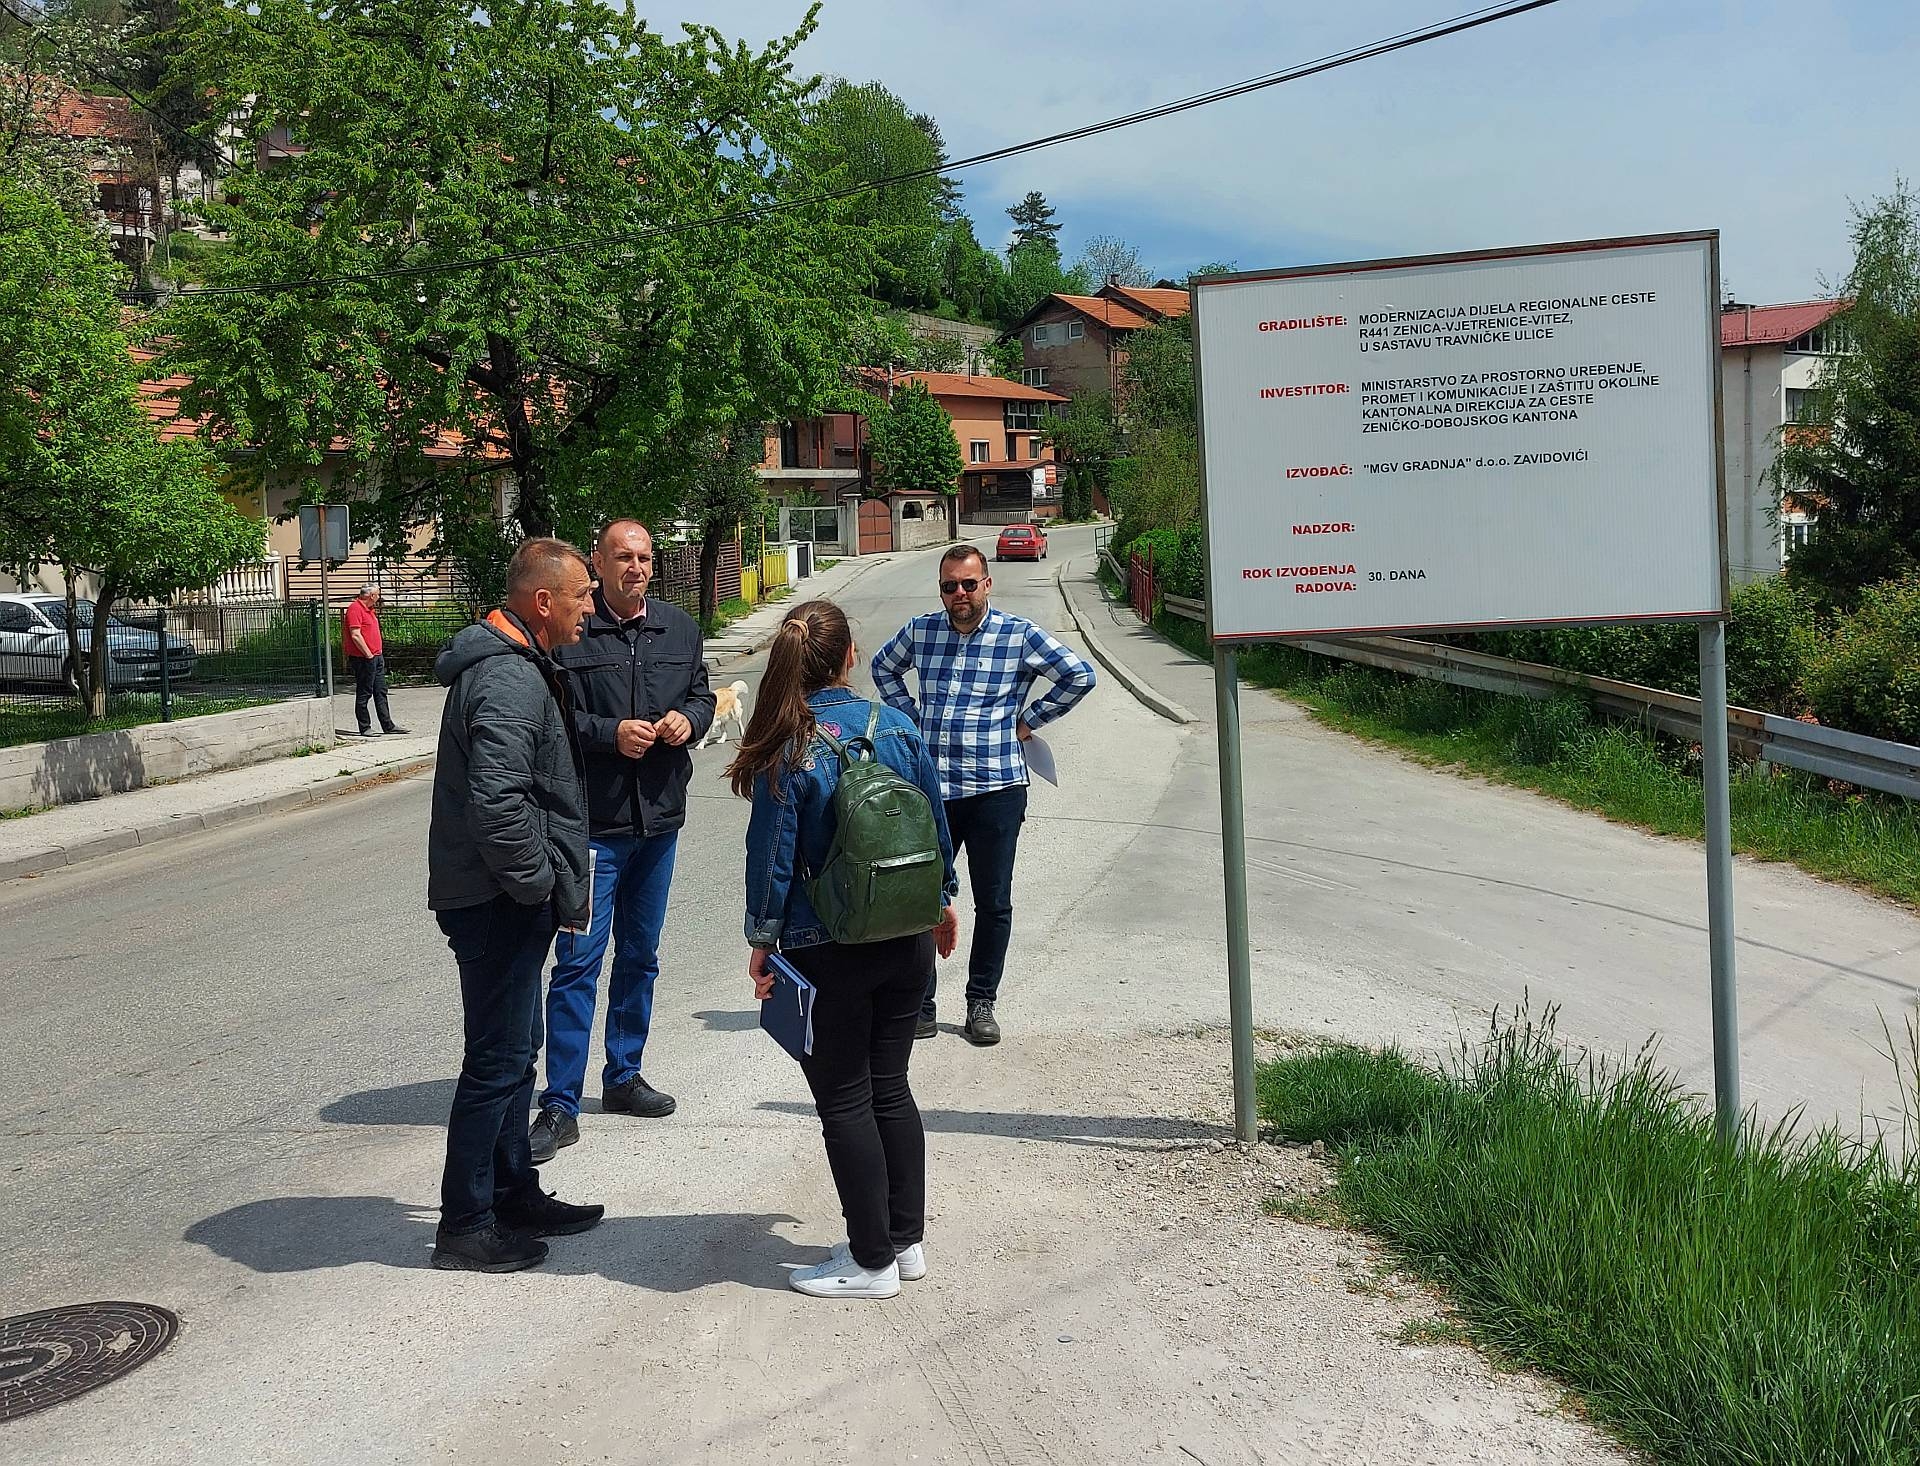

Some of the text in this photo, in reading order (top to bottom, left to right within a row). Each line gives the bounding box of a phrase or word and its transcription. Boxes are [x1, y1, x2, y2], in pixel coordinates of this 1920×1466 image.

[1258, 291, 1656, 332] GRADILIŠTE: MODERNIZACIJA DIJELA REGIONALNE CESTE
[1359, 312, 1573, 339] R441 ZENICA-VJETRENICE-VITEZ,
[1360, 328, 1554, 352] U SASTAVU TRAVNIČKE ULICE
[1260, 362, 1646, 399] INVESTITOR: MINISTARSTVO ZA PROSTORNO UREĐENJE,
[1362, 375, 1660, 405] PROMET I KOMUNIKACIJE I ZAŠTITU OKOLINE
[1362, 393, 1594, 419] KANTONALNA DIREKCIJA ZA CESTE
[1362, 409, 1578, 434] ZENIČKO-DOBOJSKOG KANTONA
[1286, 448, 1589, 479] IZVOĐAČ: "MGV GRADNJA" d.o.o. ZAVIDOVIĆI
[1292, 522, 1355, 535] NADZOR:
[1242, 564, 1356, 579] ROK IZVOĐENJA
[1368, 569, 1426, 582] 30. DANA
[1295, 581, 1357, 594] RADOVA:
